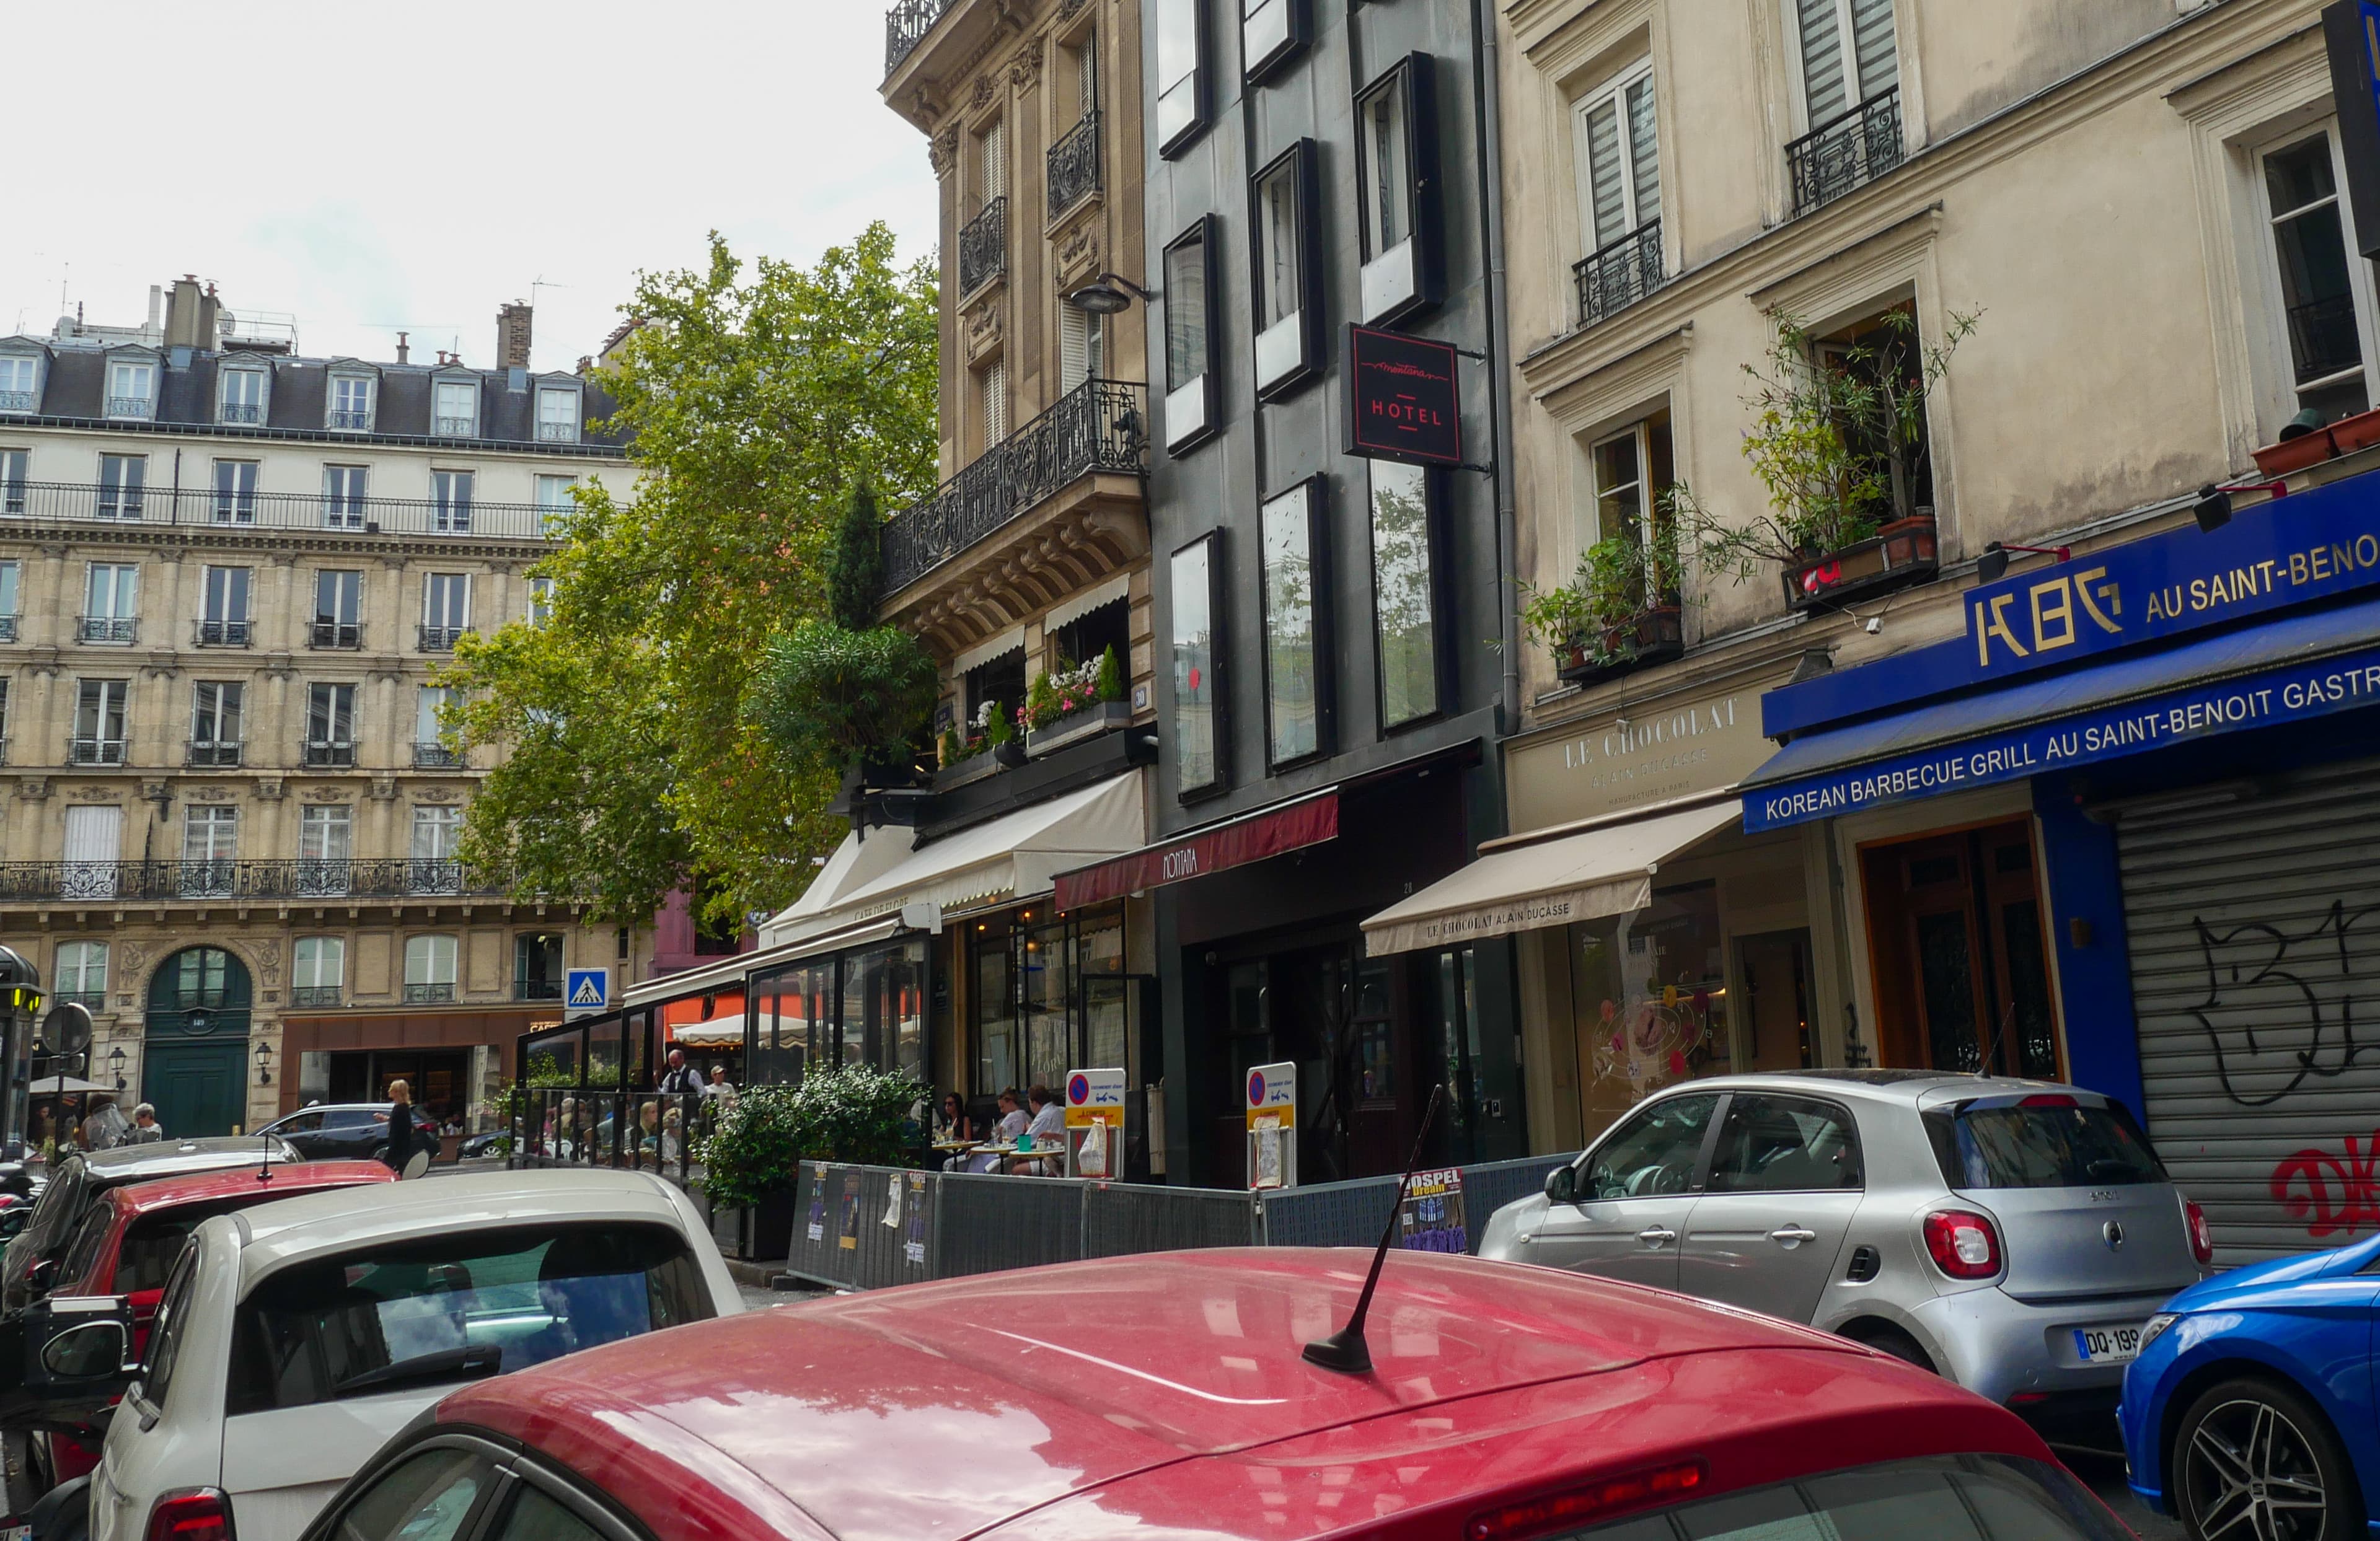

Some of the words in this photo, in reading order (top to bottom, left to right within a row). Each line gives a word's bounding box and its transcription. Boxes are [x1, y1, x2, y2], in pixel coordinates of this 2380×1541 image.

[1372, 399, 1442, 426] HOTEL
[2146, 585, 2183, 623] AU
[1135, 690, 1145, 706] 30
[1564, 739, 1593, 769] LE
[1604, 698, 1738, 758] CHOCOLAT
[1766, 784, 1846, 821] KOREAN
[1850, 757, 1965, 803] BARBECUE
[1970, 742, 2037, 777] GRILL
[2045, 732, 2078, 760] AU
[2085, 688, 2273, 752] SAINT-BENOIT
[2282, 665, 2380, 709] GASTR
[1592, 766, 1633, 789] ALAIN
[1641, 748, 1708, 777] DUCASSE
[1608, 788, 1660, 806] MANUFACTURE
[1669, 780, 1691, 792] PARIS
[1163, 847, 1197, 880] MONTANA
[1427, 925, 1438, 938] LE
[1443, 914, 1492, 934] CHOCOLAT
[1496, 910, 1523, 925] ALAIN
[1527, 903, 1569, 921] DUCASSE
